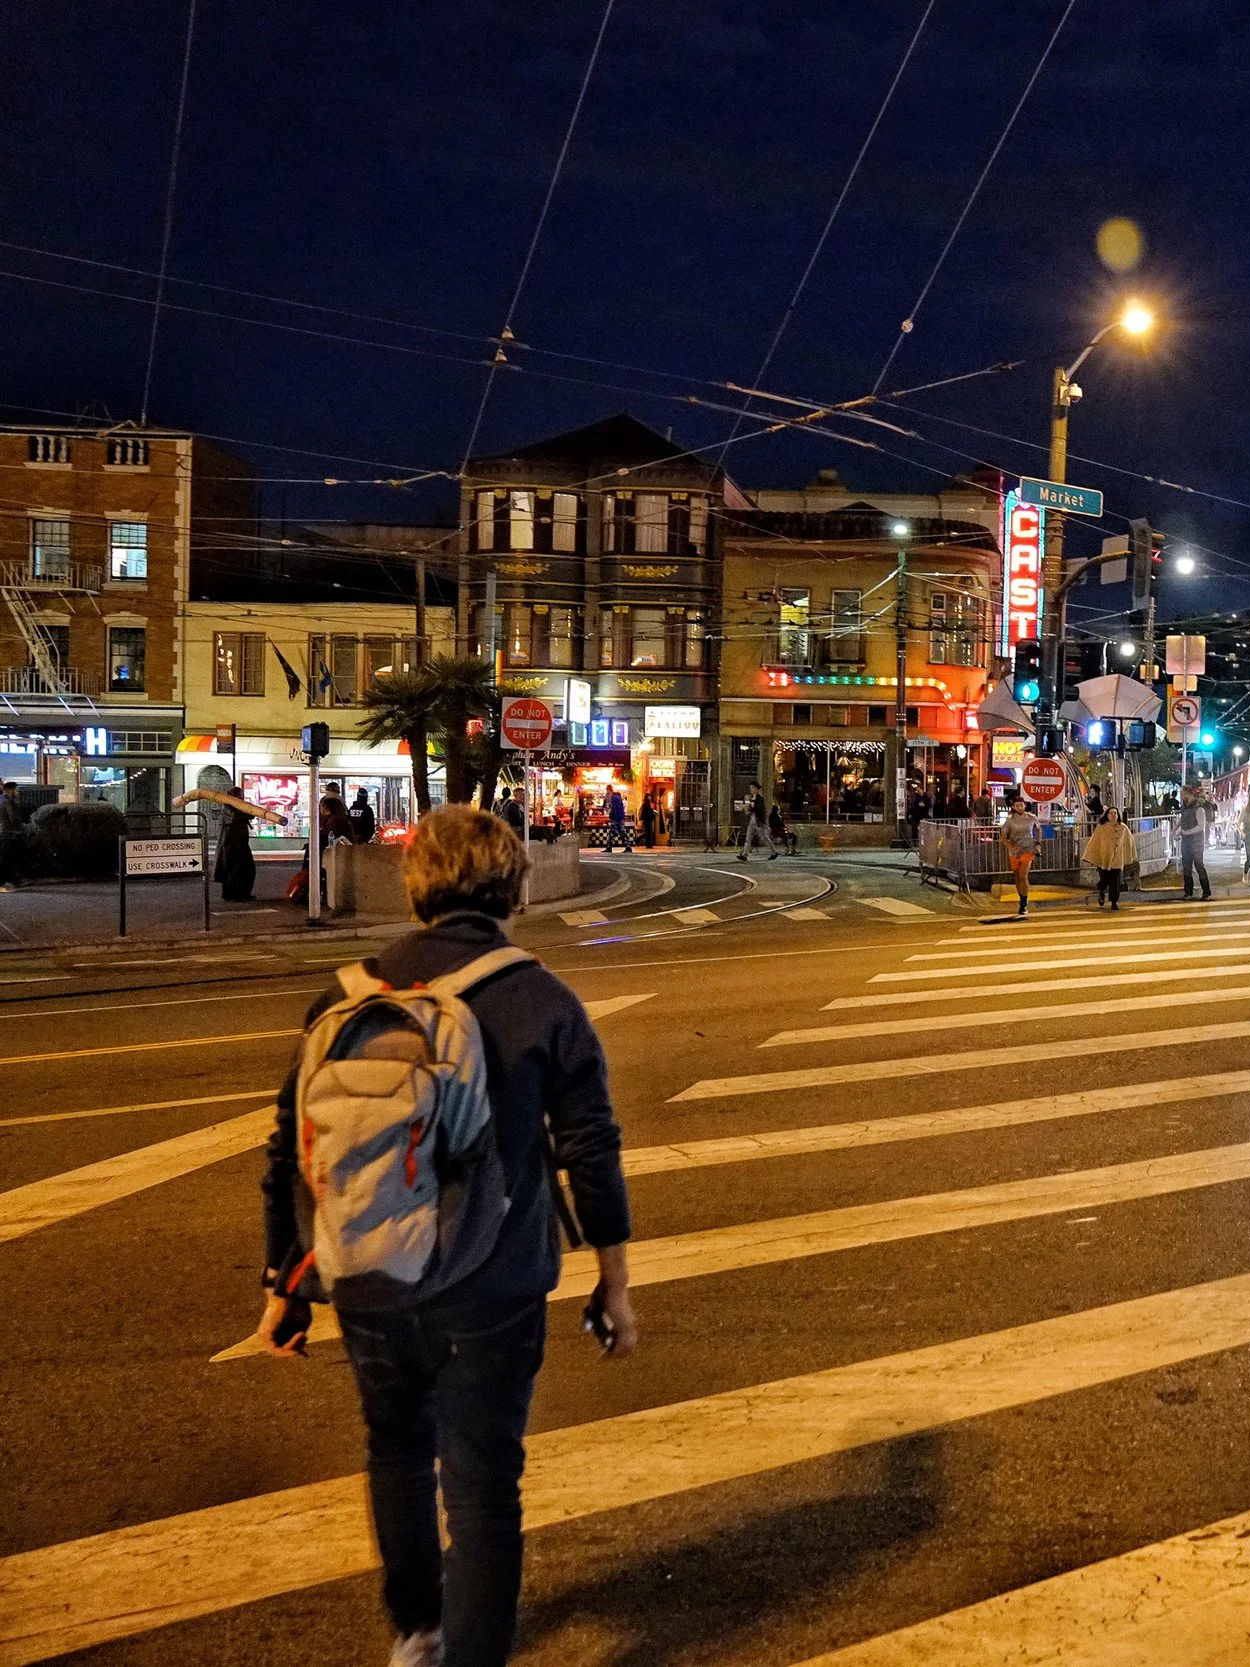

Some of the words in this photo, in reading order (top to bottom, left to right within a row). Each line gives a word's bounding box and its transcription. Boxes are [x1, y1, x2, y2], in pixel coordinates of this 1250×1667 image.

[1039, 486, 1084, 508] Market
[1011, 510, 1038, 638] CAST
[510, 709, 523, 717] DO
[528, 710, 546, 718] NOT
[513, 730, 541, 740] ENTER
[993, 741, 1022, 755] HOT
[506, 749, 535, 759] phan
[541, 749, 576, 763] Andy's
[145, 844, 159, 852] PED
[162, 843, 195, 851] CROSSING
[147, 861, 187, 870] CROSSWALK
